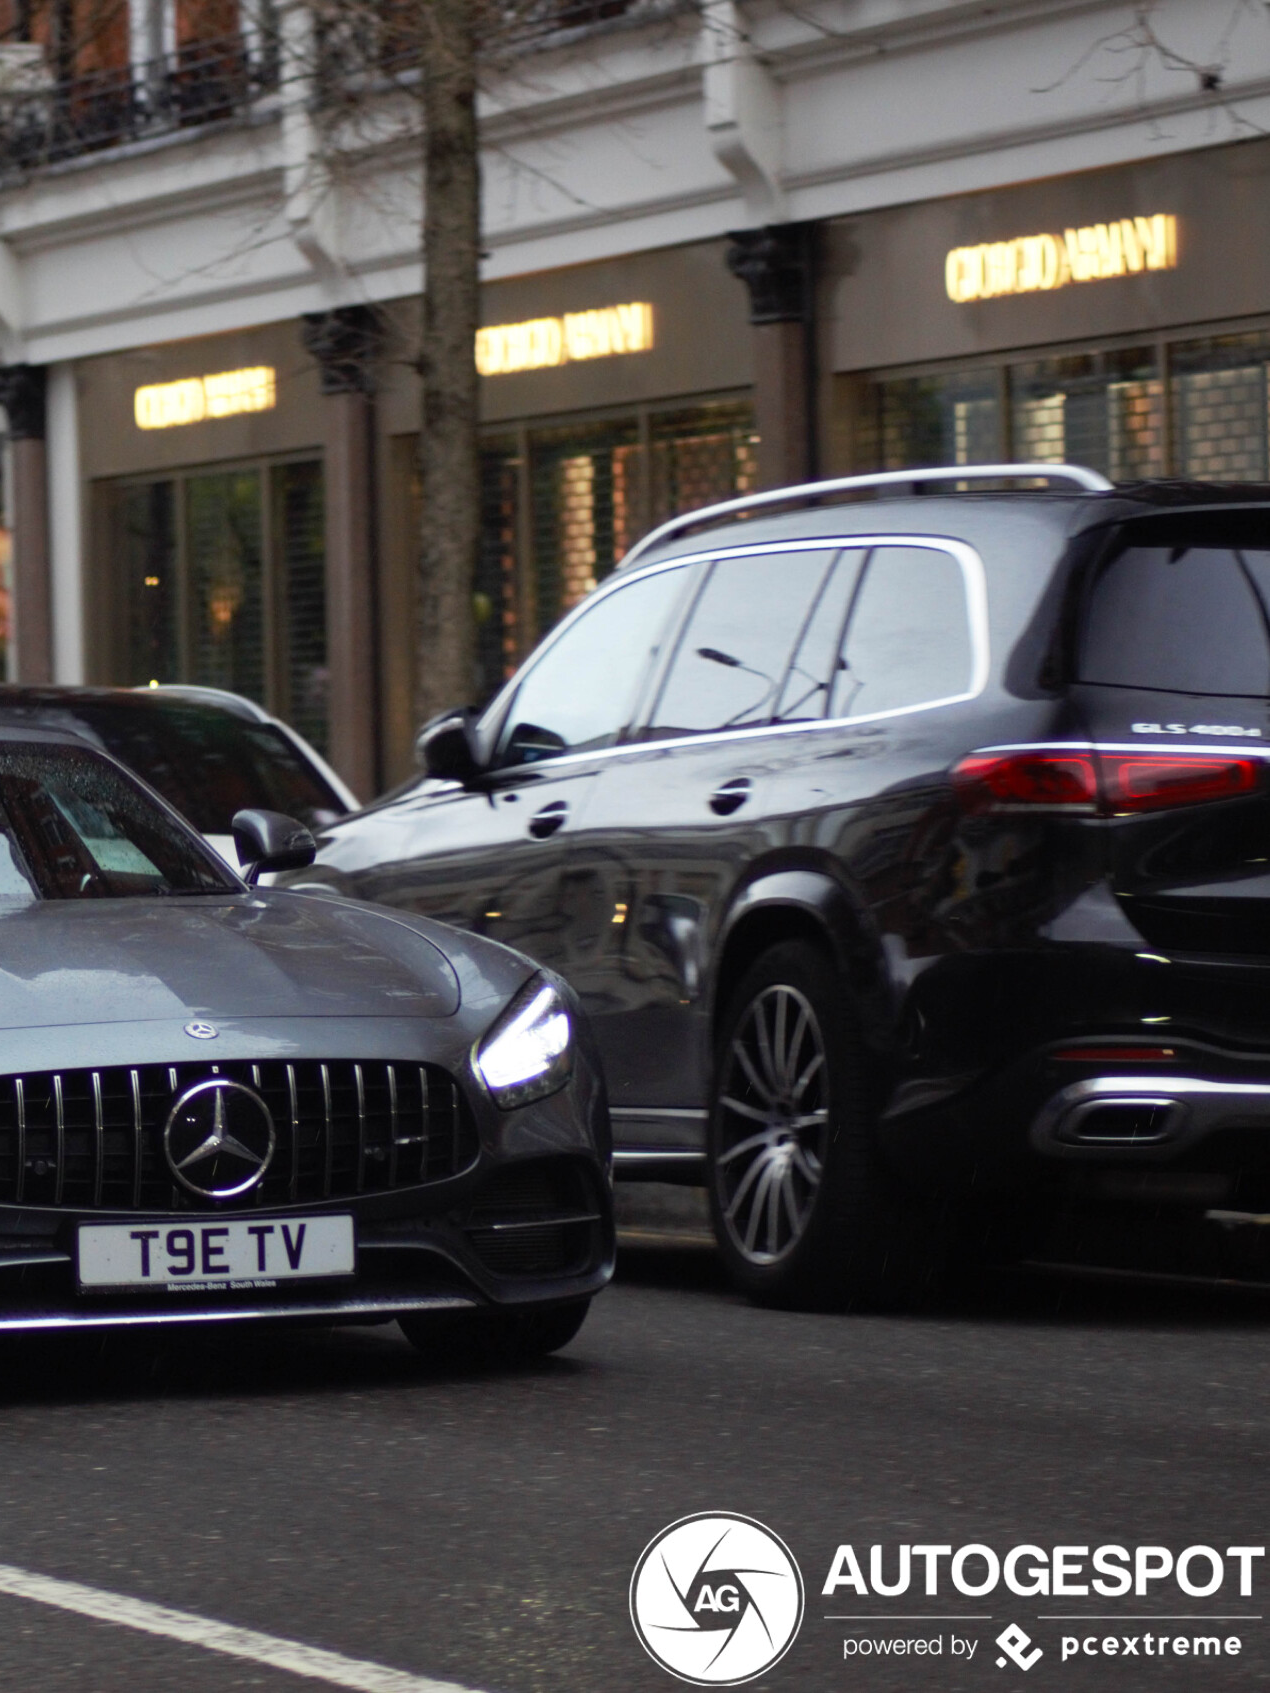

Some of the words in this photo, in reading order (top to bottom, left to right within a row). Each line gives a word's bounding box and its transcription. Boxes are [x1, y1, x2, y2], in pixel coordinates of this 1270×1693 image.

[1131, 722, 1187, 734] GLS
[130, 1228, 230, 1277] T9E
[247, 1223, 307, 1272] TV
[167, 1282, 227, 1292] Mercedes-Benz
[230, 1280, 253, 1290] South
[253, 1279, 276, 1288] Wales
